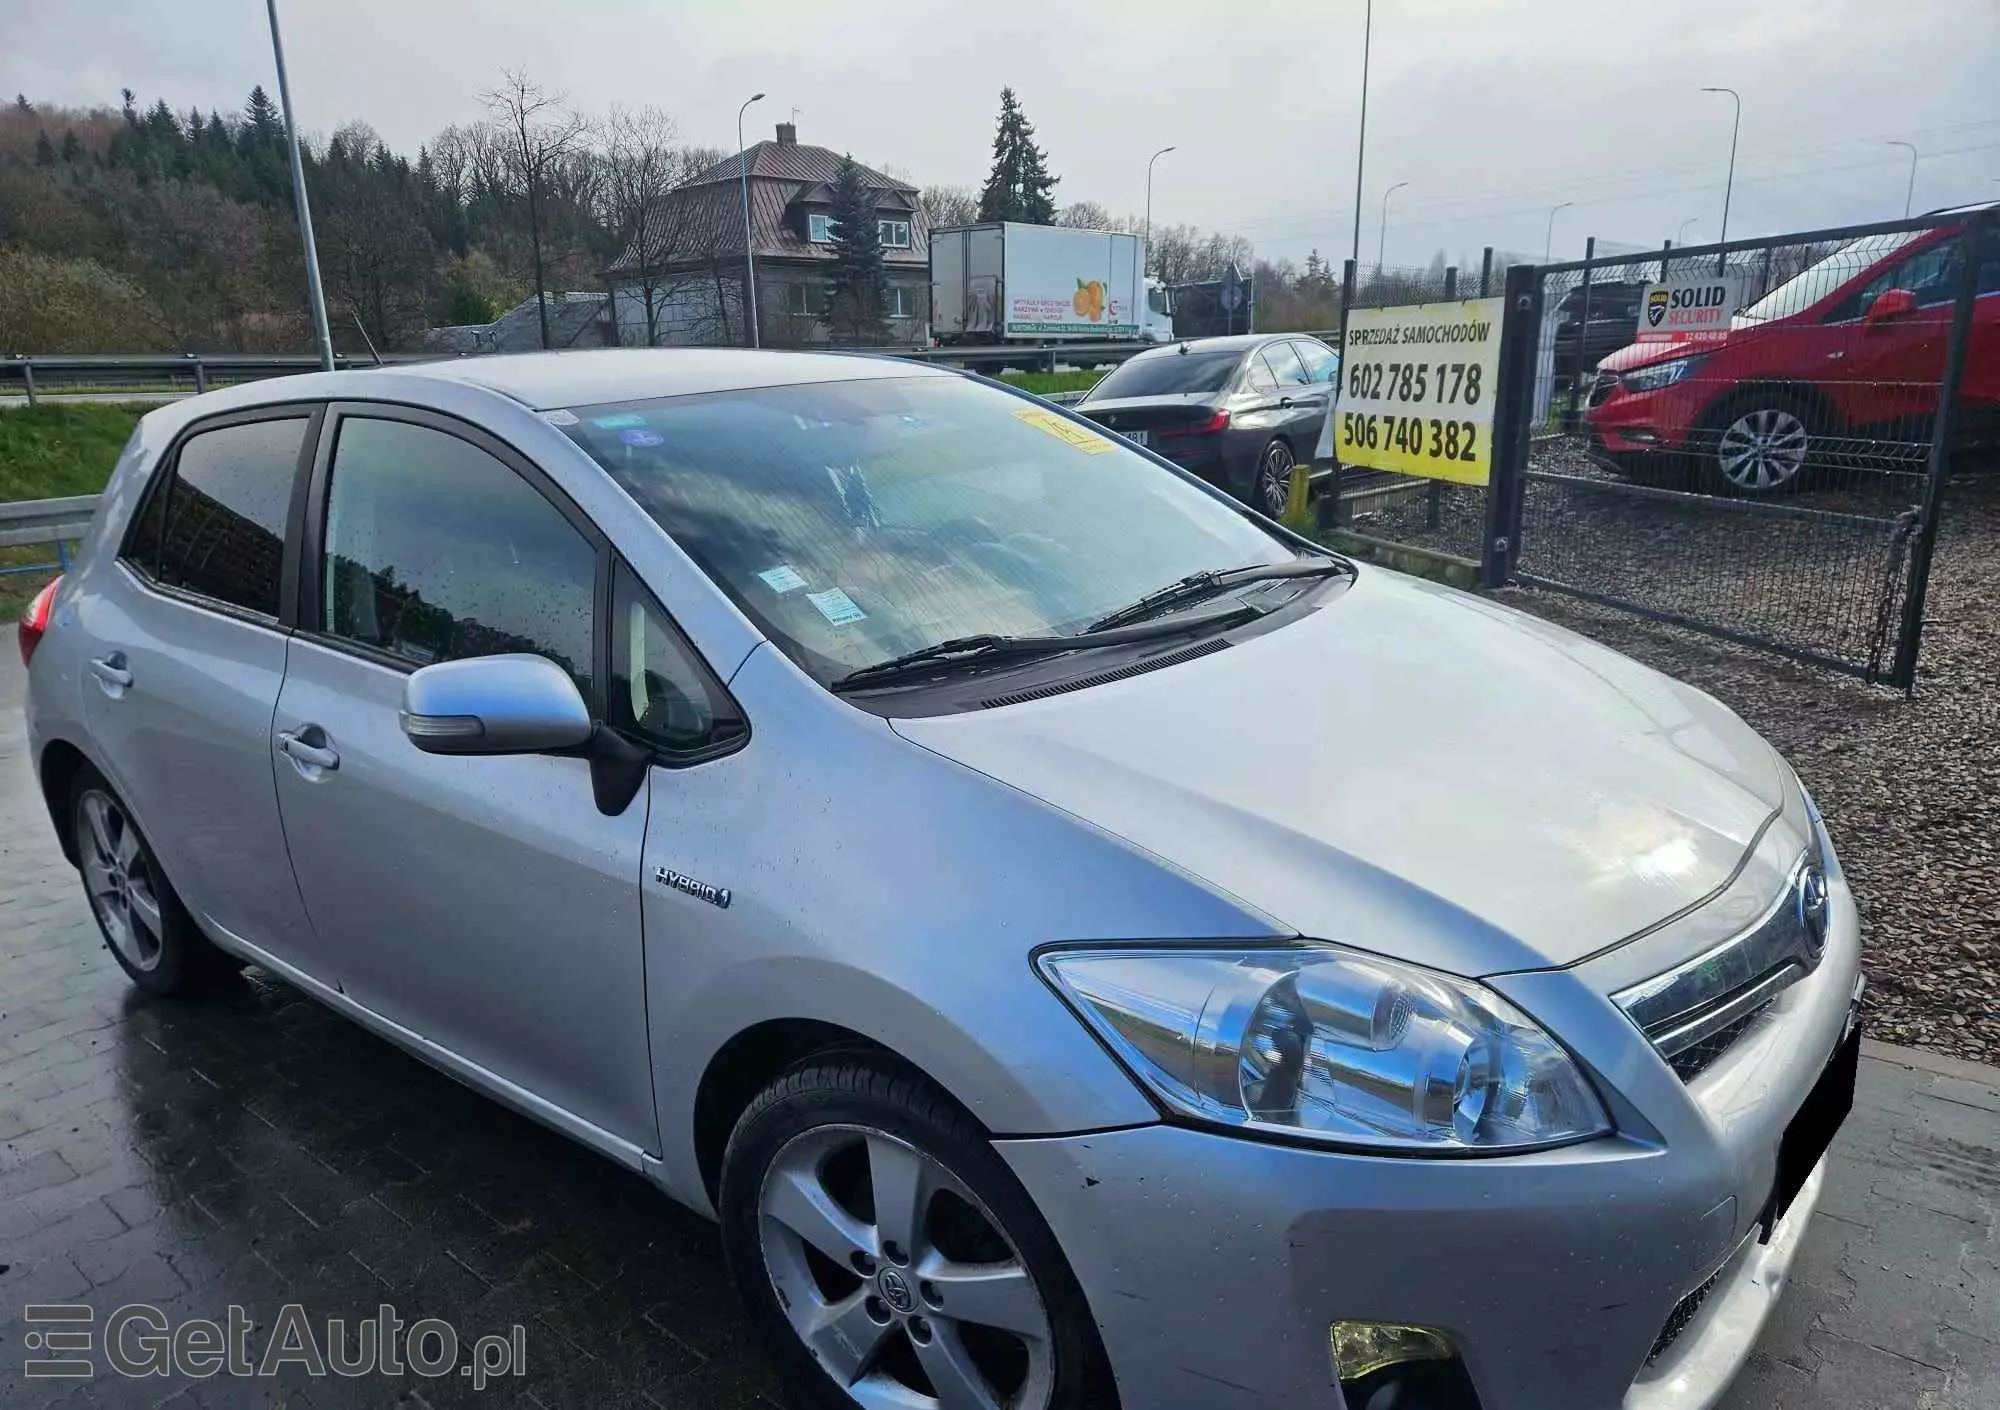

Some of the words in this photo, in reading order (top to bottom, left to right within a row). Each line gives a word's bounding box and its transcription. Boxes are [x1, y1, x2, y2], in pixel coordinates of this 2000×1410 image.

[1671, 286, 1726, 309] SOLID
[1348, 323, 1400, 346] SPRZEDAŻ
[1402, 319, 1491, 345] SAMOCHODÓW
[1667, 308, 1724, 325] SECURITY
[1349, 362, 1383, 400] 602
[1387, 362, 1429, 403] 785
[1436, 362, 1482, 405] 178
[1344, 412, 1377, 450] 506
[1383, 415, 1423, 456] 740
[1429, 419, 1477, 462] 382
[655, 866, 719, 905] HYBRID
